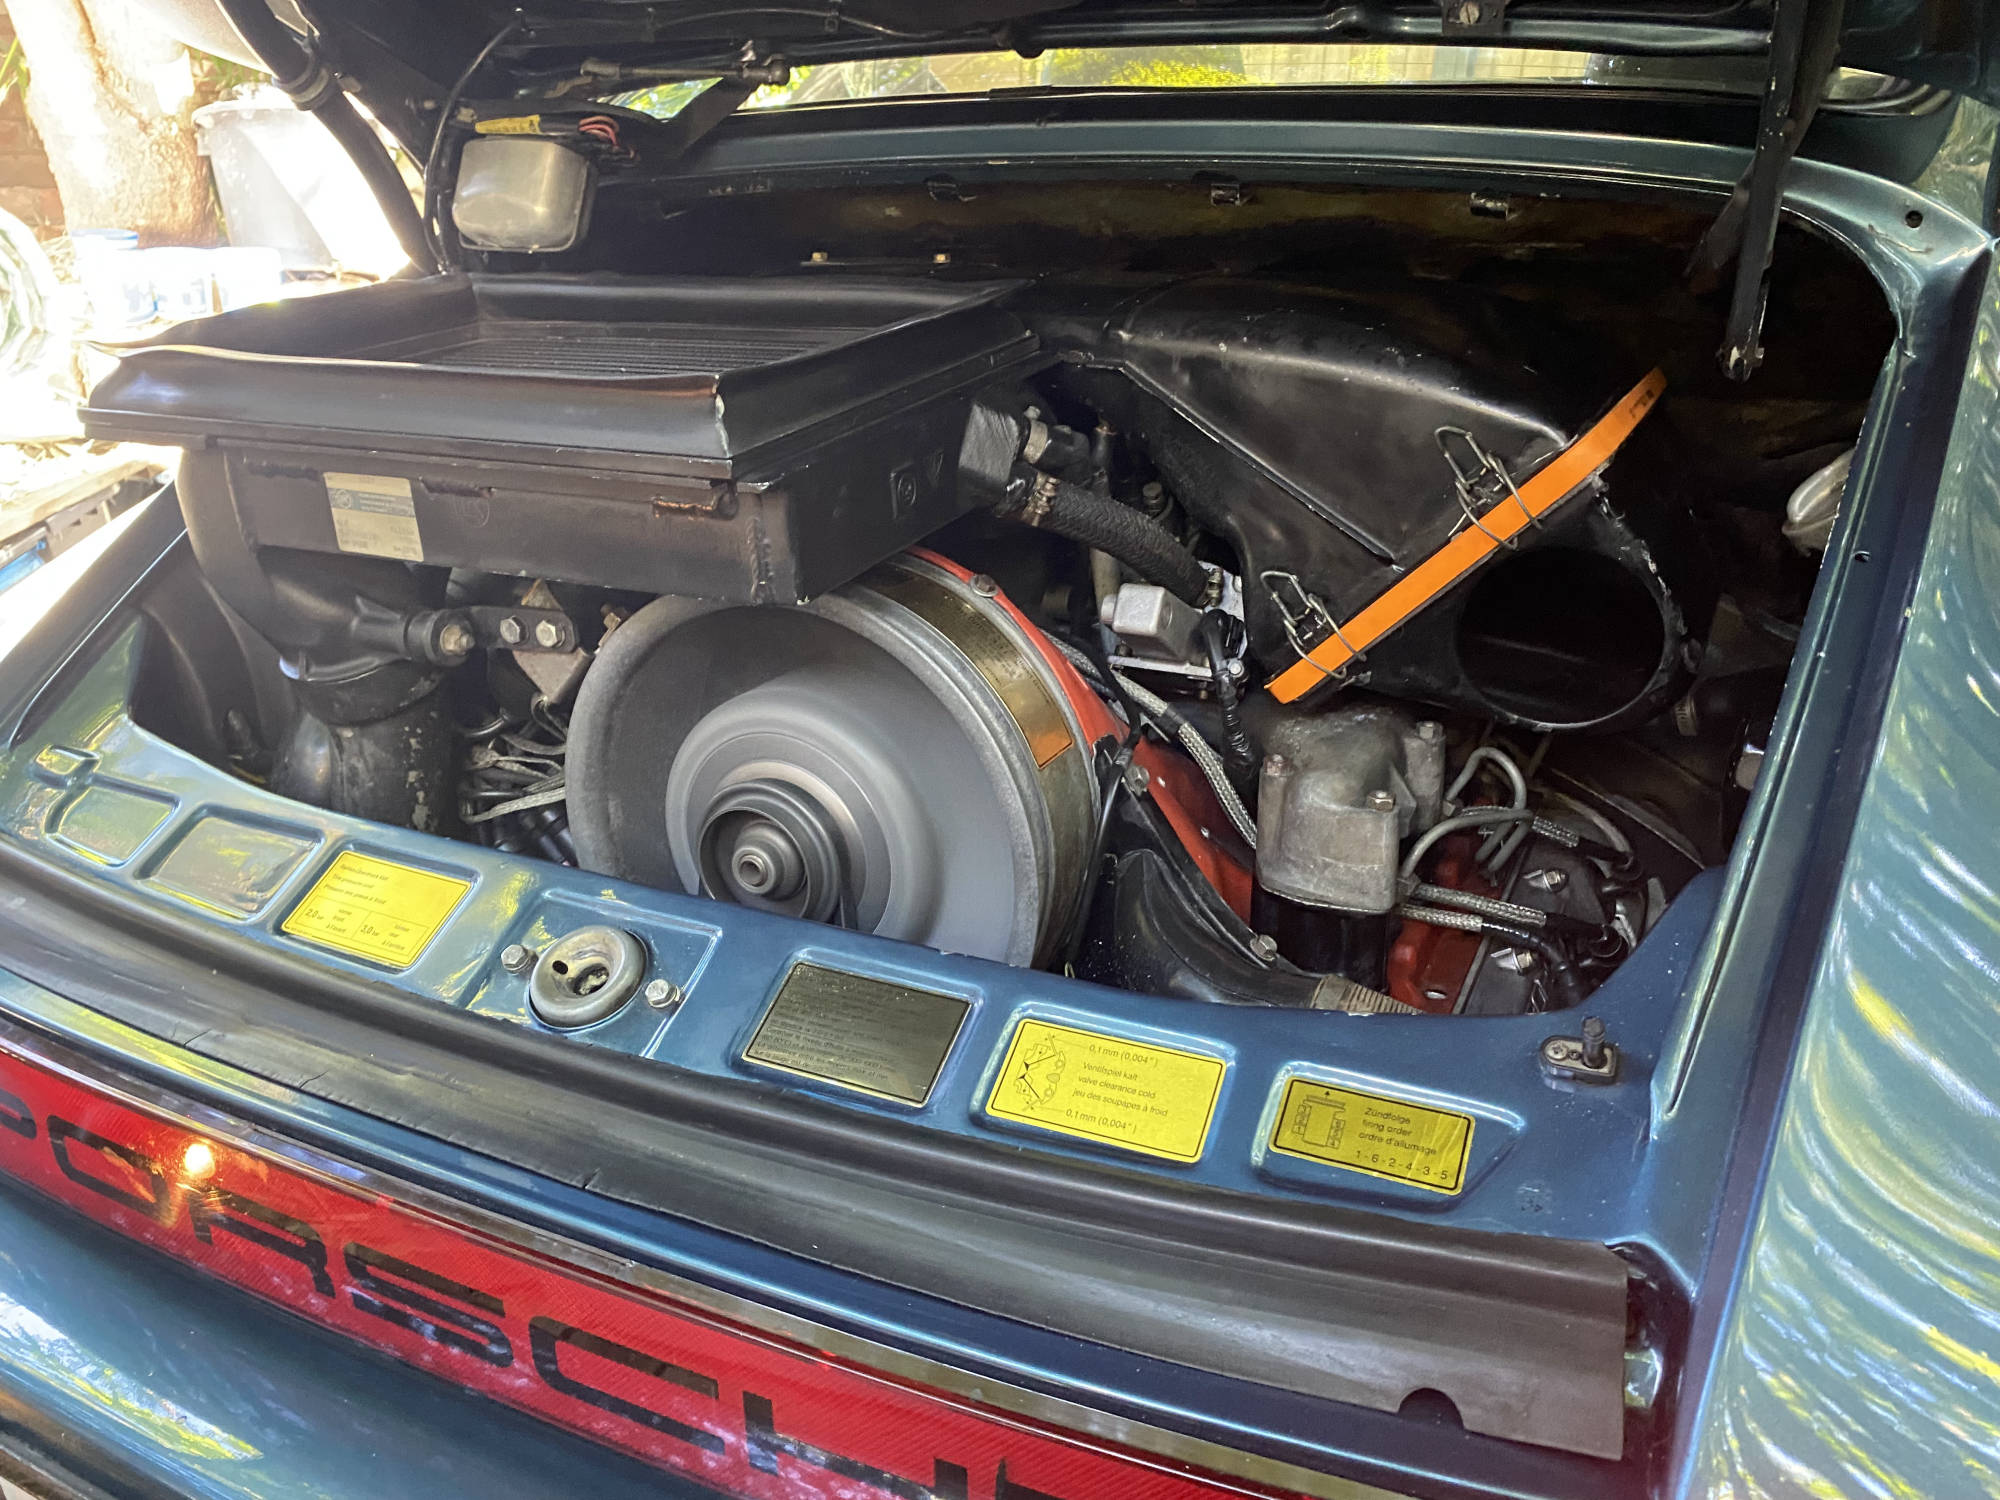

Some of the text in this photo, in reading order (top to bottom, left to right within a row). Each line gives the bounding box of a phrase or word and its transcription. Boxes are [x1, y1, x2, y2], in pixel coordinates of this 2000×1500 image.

[1102, 1046, 1119, 1057] mm
[1123, 1071, 1138, 1081] kalt
[1078, 1076, 1156, 1099] valve clearance cold
[1072, 1088, 1086, 1097] jeu
[1086, 1091, 1102, 1102] des
[1102, 1096, 1141, 1111] soupapes
[1149, 1105, 1168, 1117] froid
[1080, 1112, 1097, 1123] mm
[1362, 1119, 1412, 1136] firing order
[1358, 1131, 1437, 1156] ordre d'allumage
